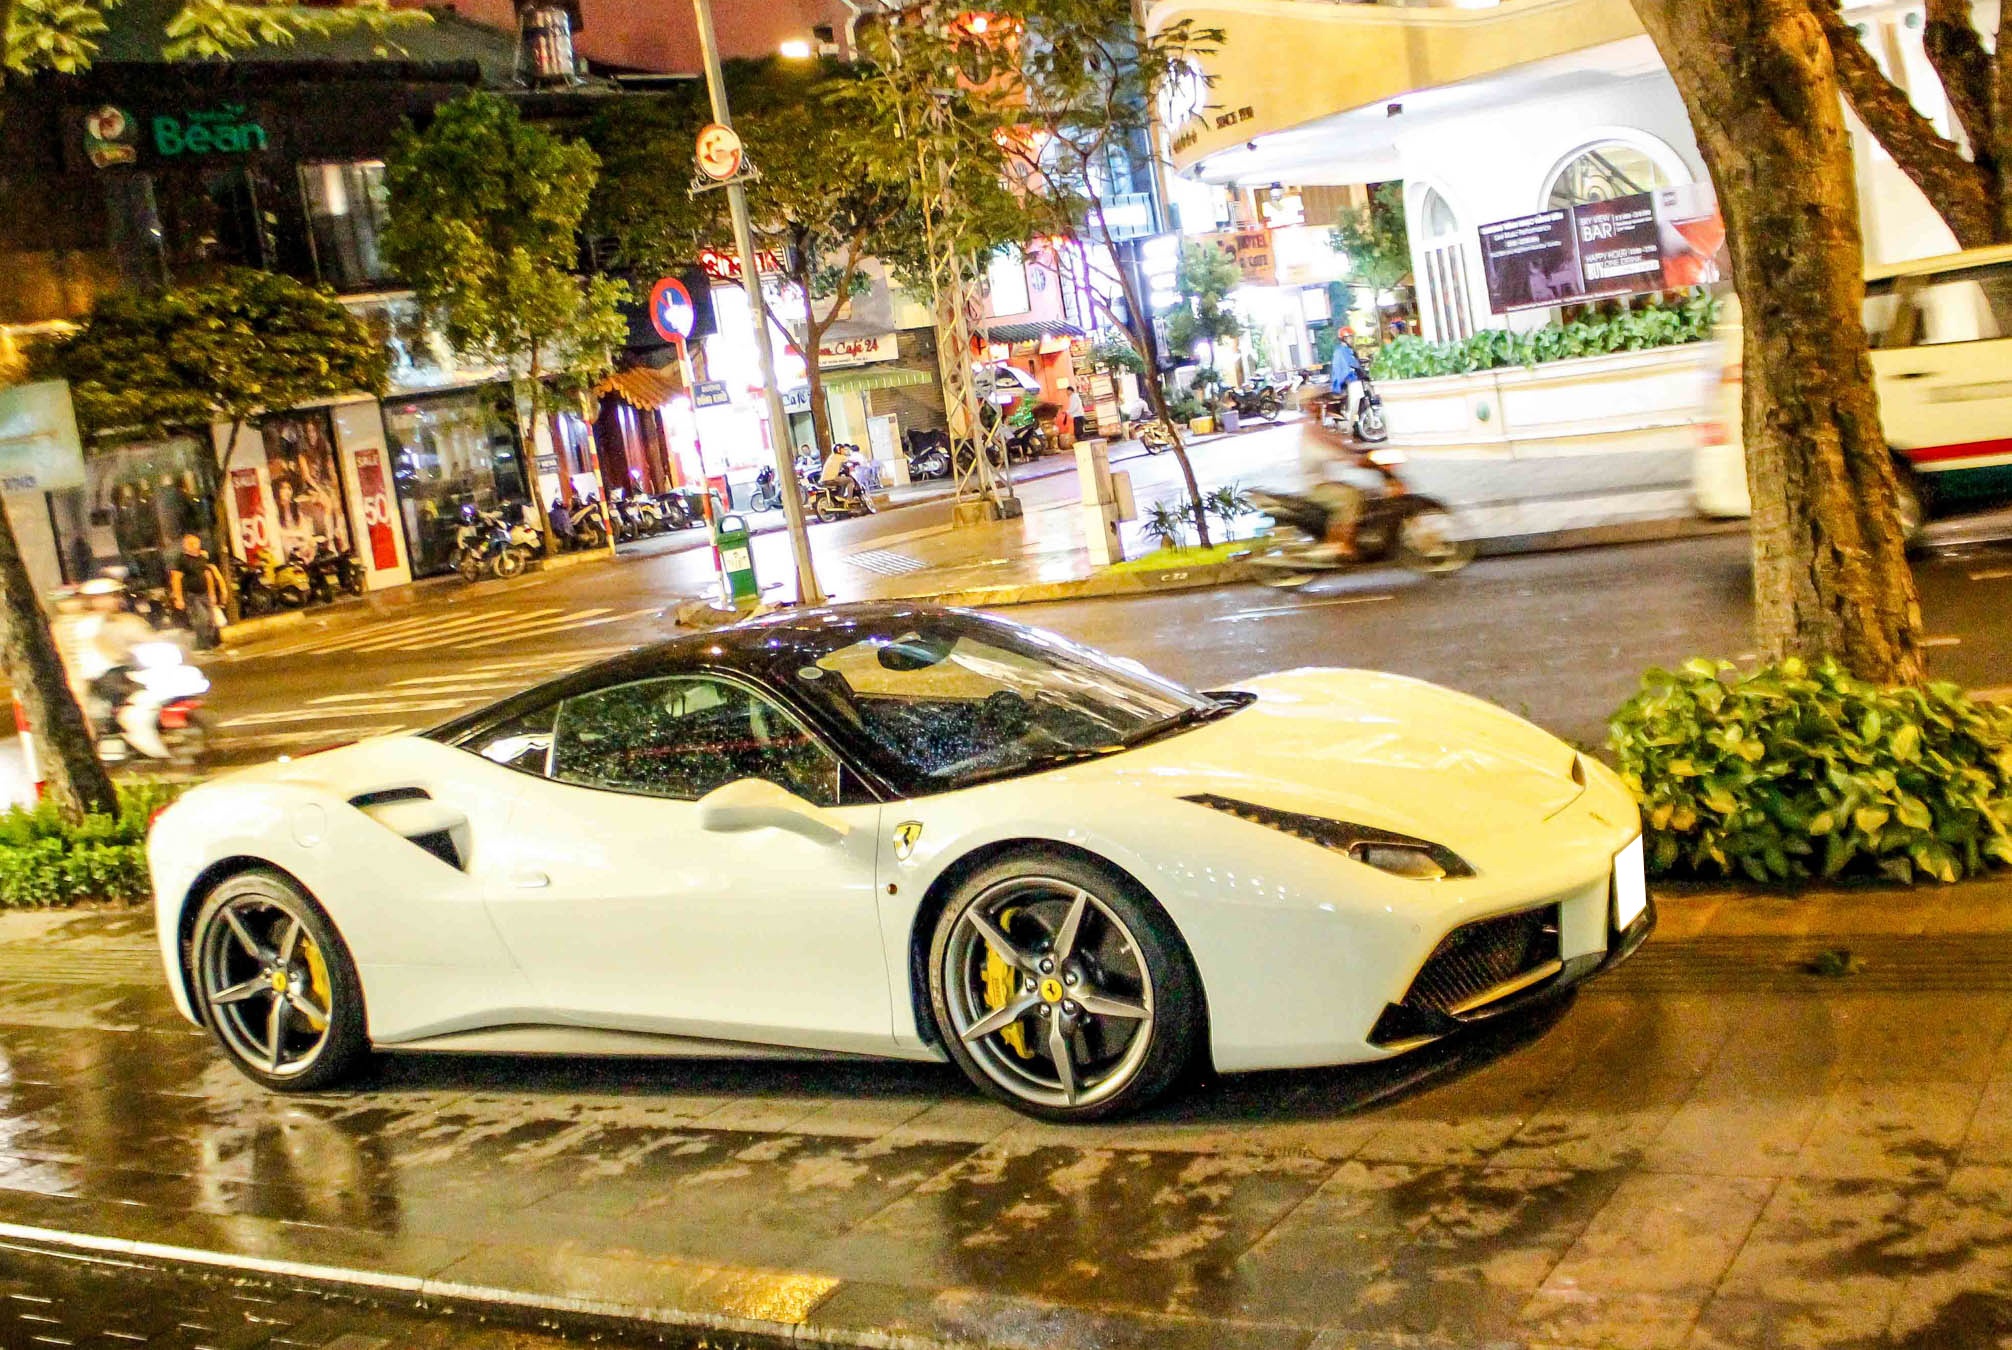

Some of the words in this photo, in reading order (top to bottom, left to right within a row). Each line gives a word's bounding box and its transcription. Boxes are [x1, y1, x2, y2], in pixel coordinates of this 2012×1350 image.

[152, 116, 268, 156] Bean
[1582, 223, 1613, 242] BAR
[1585, 252, 1608, 264] HAPPY
[1608, 249, 1627, 261] HOUR
[1584, 261, 1604, 280] BUY
[835, 337, 863, 357] Café
[864, 338, 878, 352] 24
